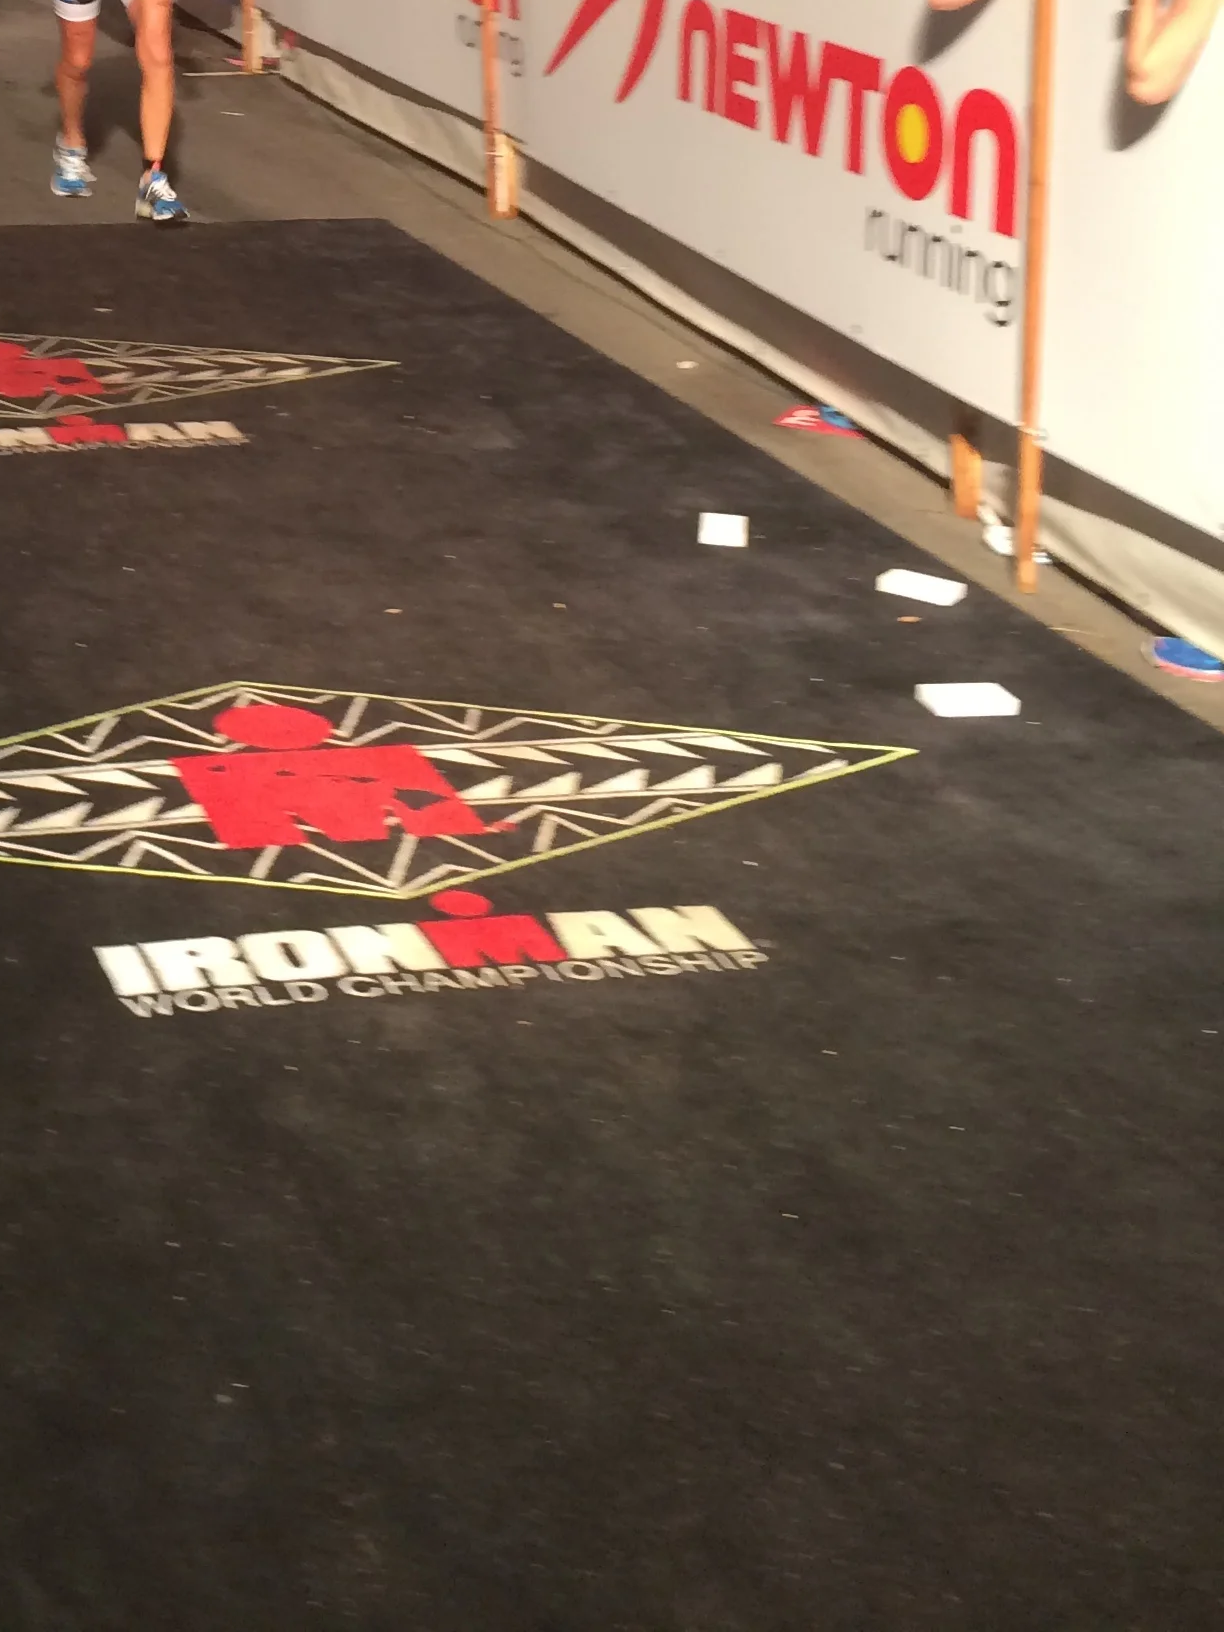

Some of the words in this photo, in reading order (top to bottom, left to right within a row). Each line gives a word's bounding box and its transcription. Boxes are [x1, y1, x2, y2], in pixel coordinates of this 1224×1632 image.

[864, 207, 1020, 328] running
[92, 889, 758, 997] IRONMAN
[119, 981, 329, 1018] WORLD
[337, 951, 771, 1000] CHAMPIONSHIP
